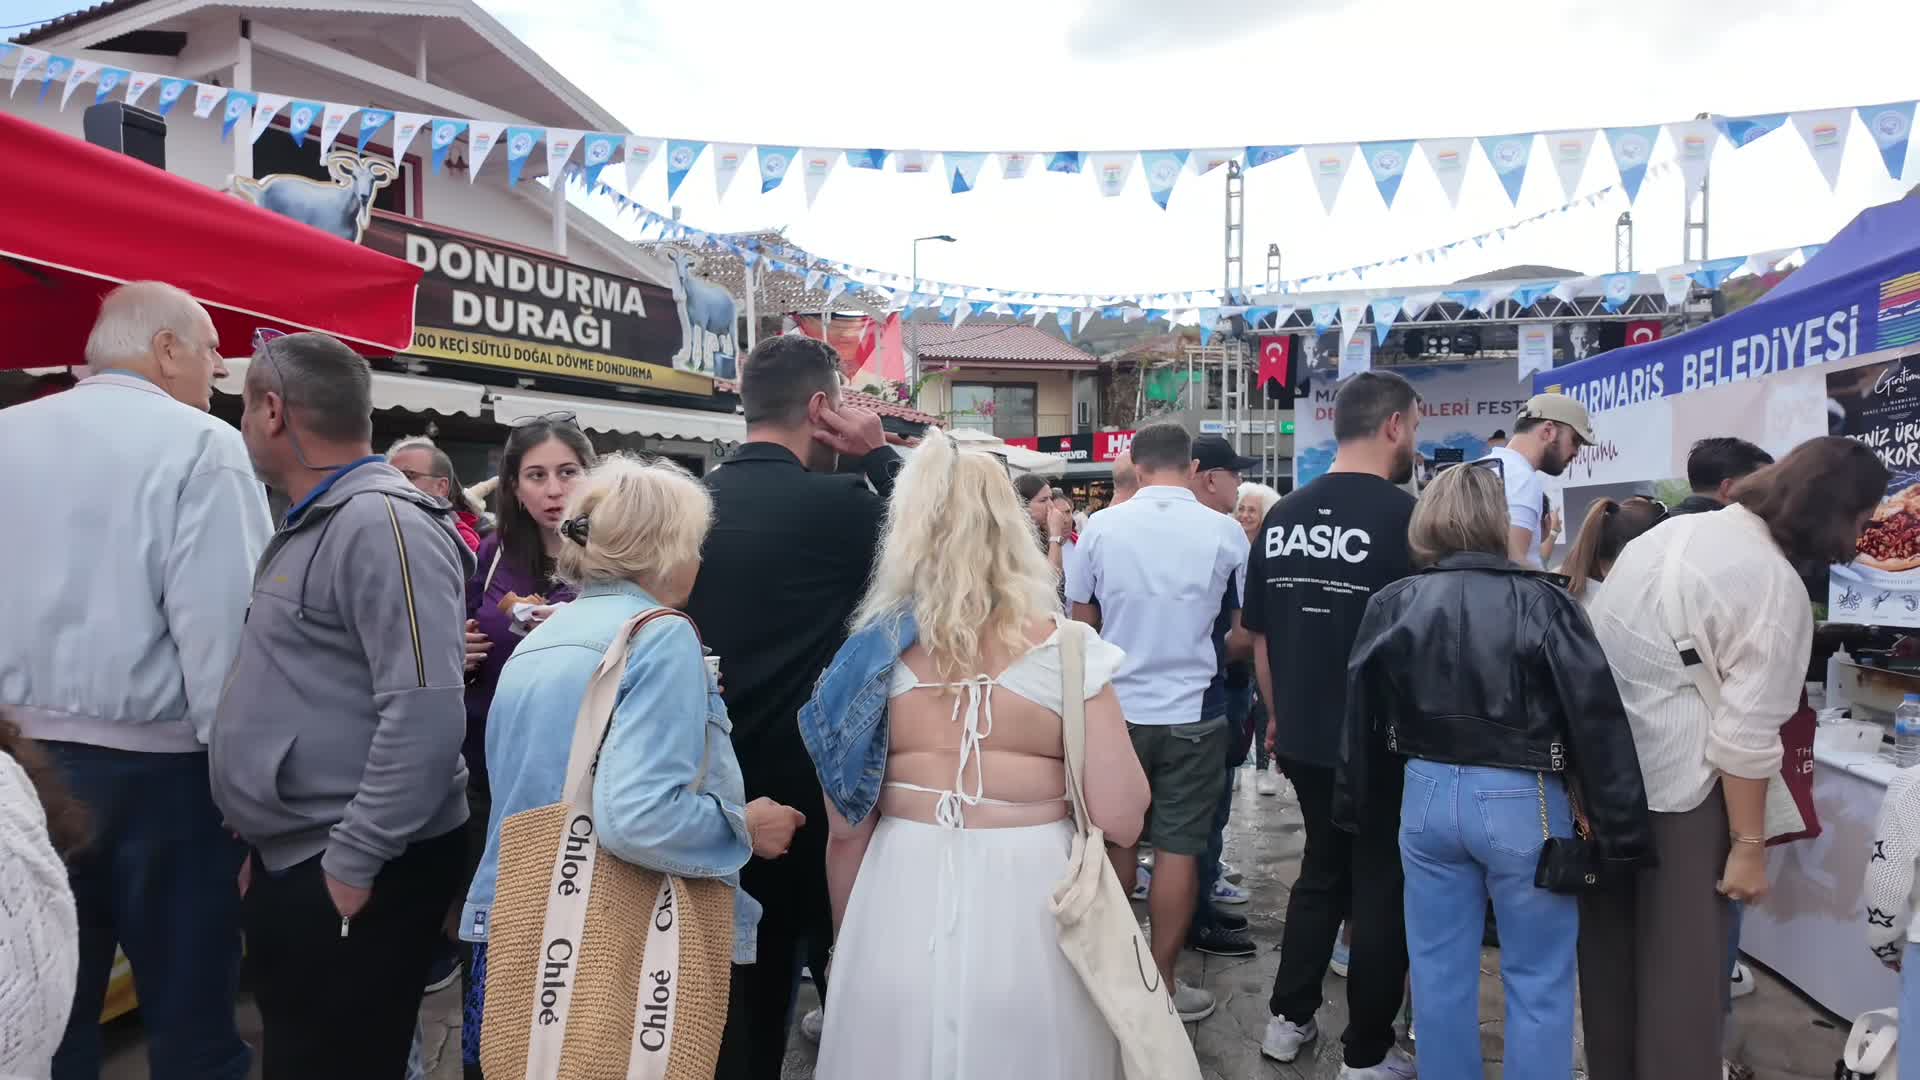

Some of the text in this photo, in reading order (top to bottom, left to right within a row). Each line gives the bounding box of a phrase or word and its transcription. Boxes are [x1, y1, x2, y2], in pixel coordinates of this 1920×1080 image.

[406, 232, 648, 319] DONDURMA
[439, 335, 469, 354] KEÇİ
[472, 338, 512, 360] SÜTLÜ
[514, 347, 554, 366] DOĞAL
[556, 353, 595, 372] DÖVME
[597, 360, 654, 381] DONDURMA
[452, 289, 612, 350] DURAĞI
[1682, 305, 1859, 393] BELEDİYESİ
[1844, 425, 1891, 448] ENİZ
[1265, 524, 1371, 563] BASIC
[557, 813, 594, 897] Chloé
[538, 937, 574, 1026] Chloé
[639, 968, 672, 1053] Chloé
